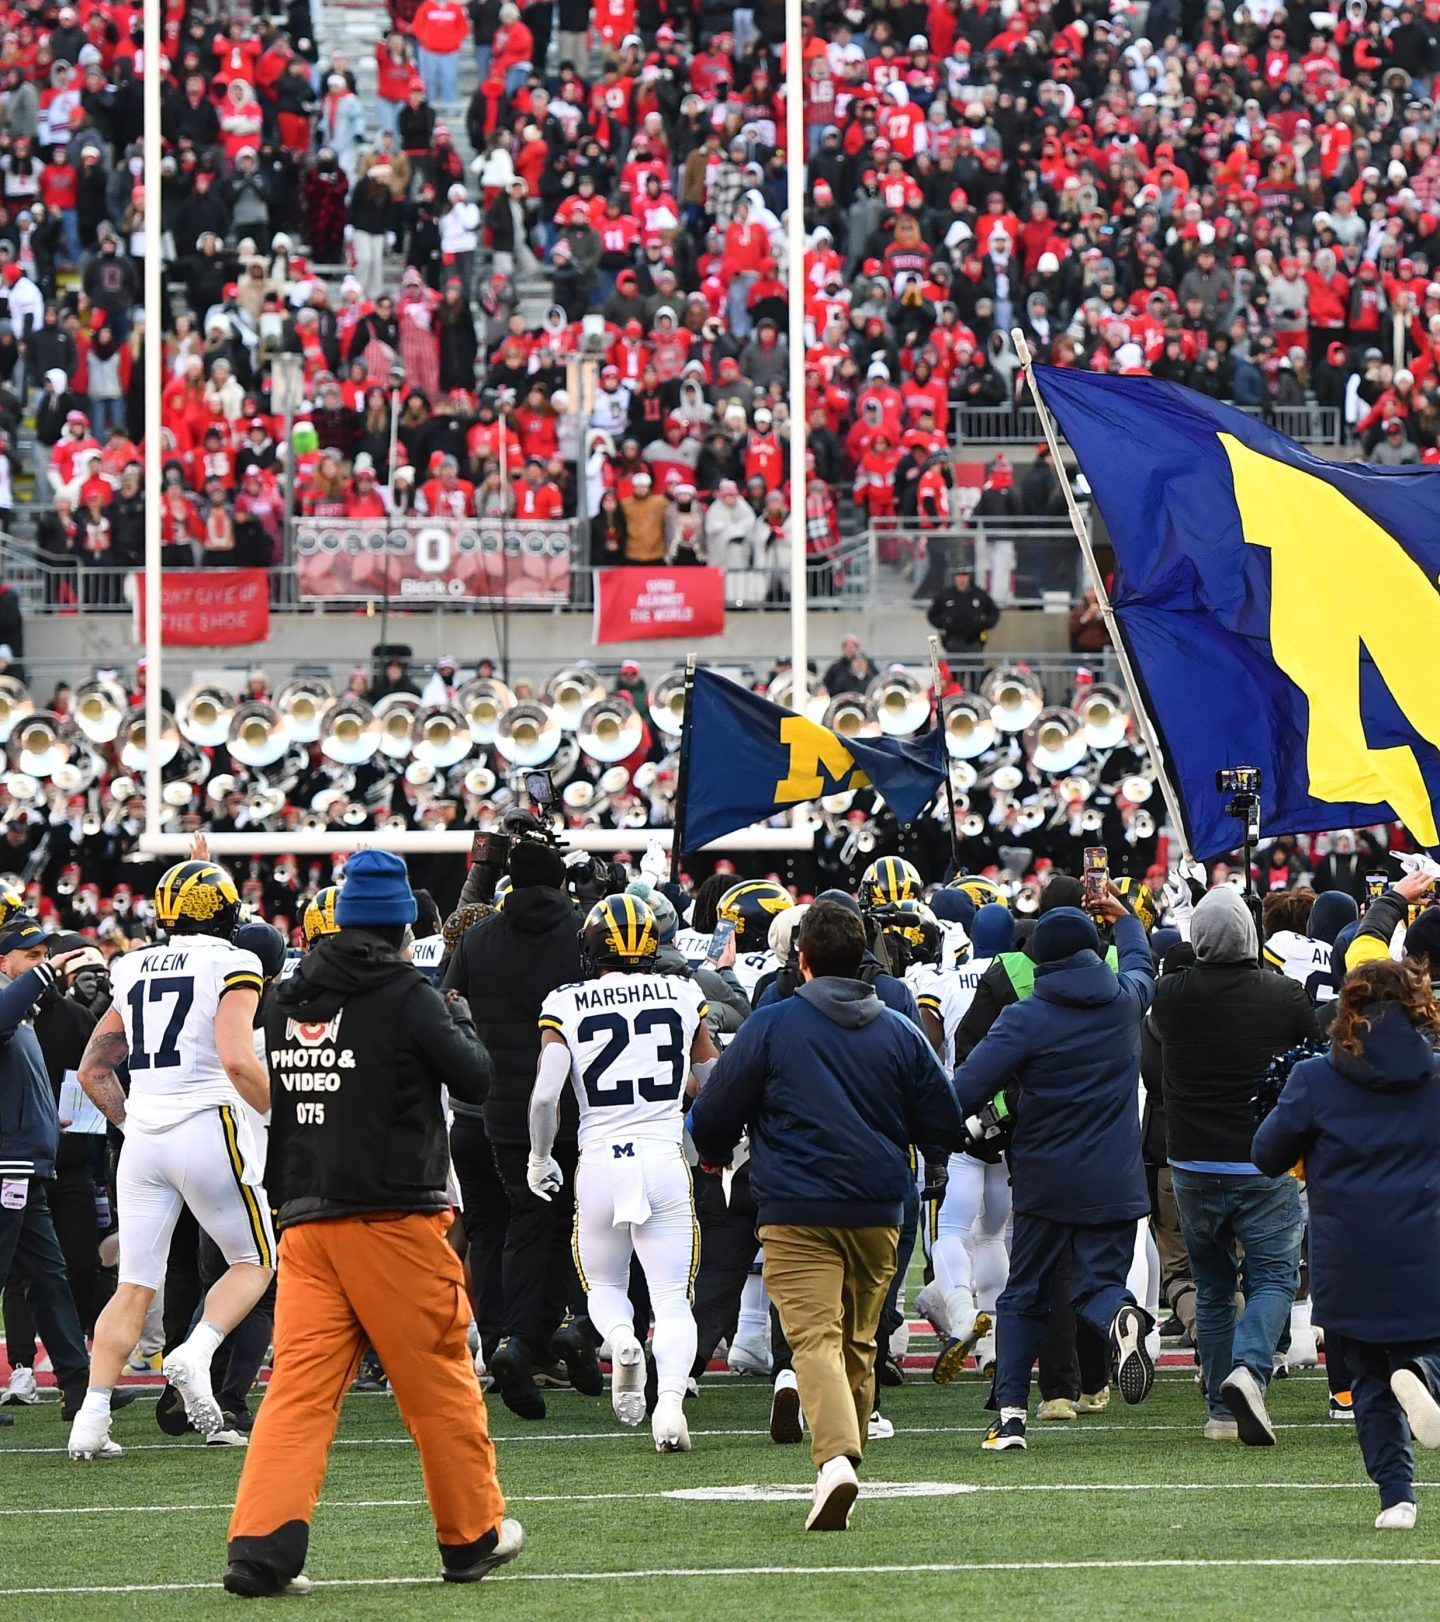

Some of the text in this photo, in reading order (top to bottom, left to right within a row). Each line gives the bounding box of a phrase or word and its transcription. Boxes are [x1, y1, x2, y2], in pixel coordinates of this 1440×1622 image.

[630, 608, 650, 624] THE
[140, 953, 189, 973] KLEIN
[574, 982, 678, 1011] MARSHALL
[127, 976, 195, 1070] 17
[271, 1048, 356, 1069] PHOTO &
[577, 1007, 685, 1107] 23
[280, 1072, 341, 1092] VIDEO
[296, 1102, 325, 1125] 075
[612, 1142, 635, 1159] M
